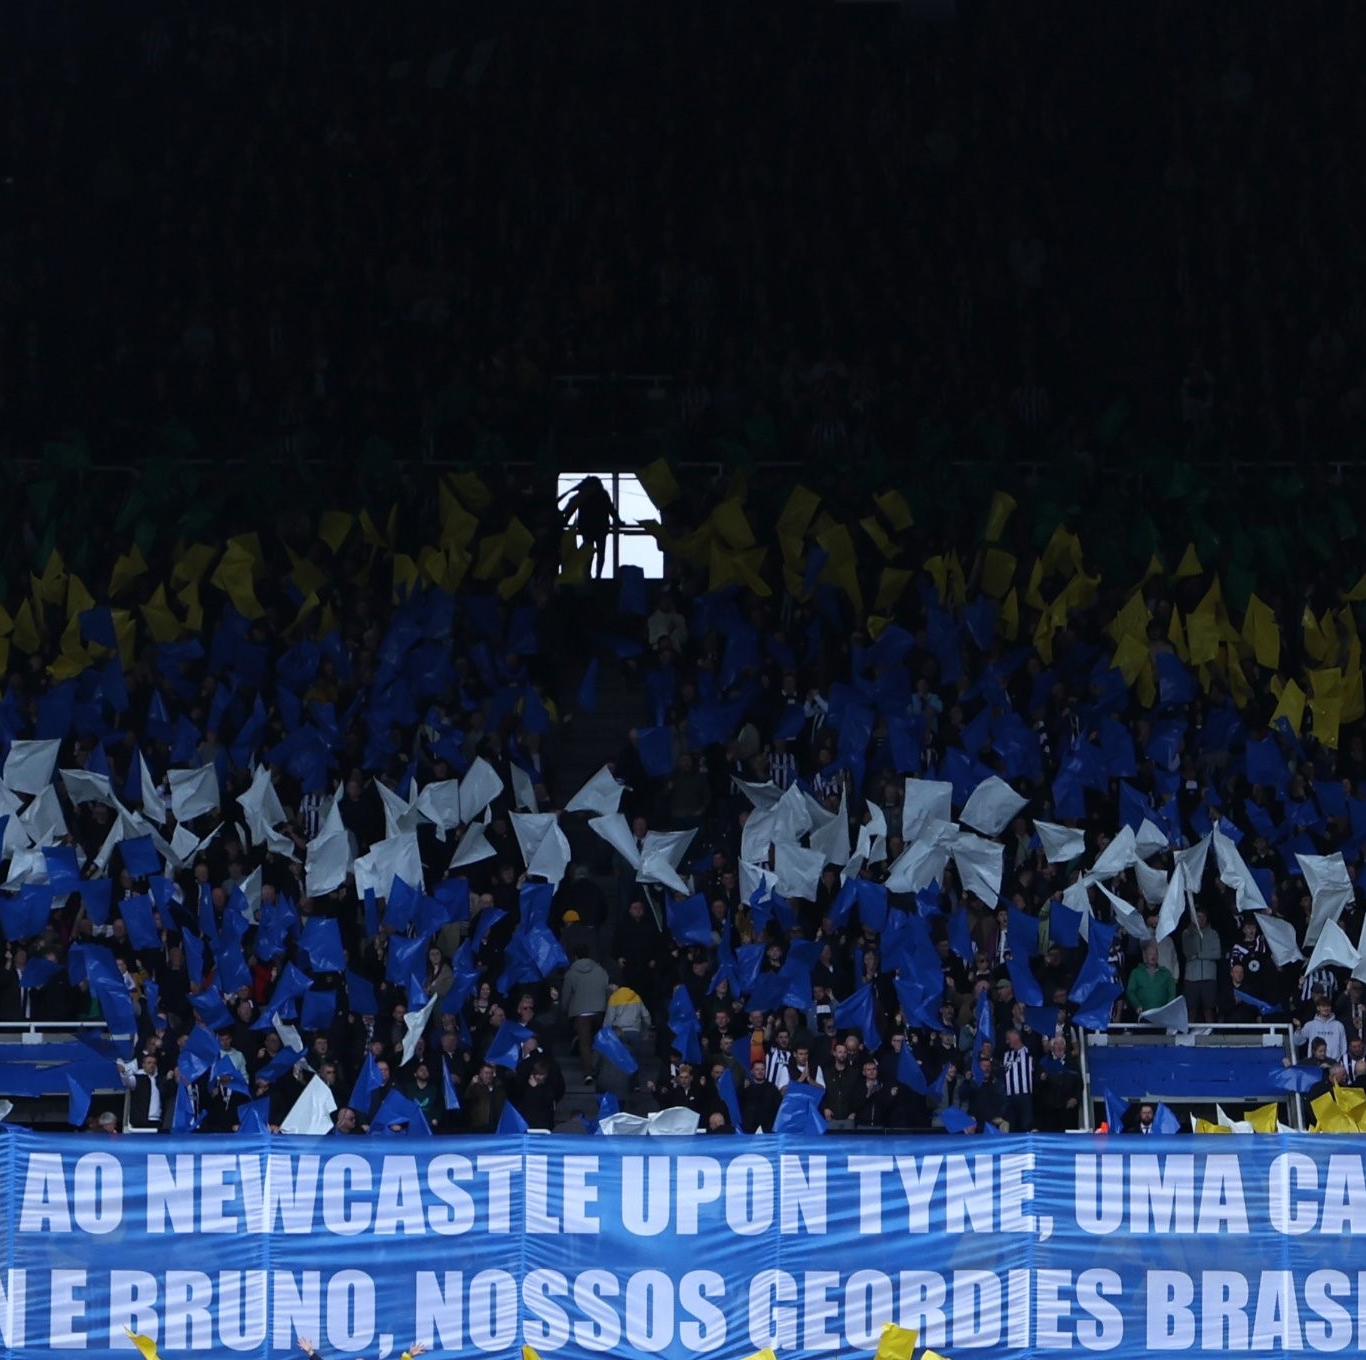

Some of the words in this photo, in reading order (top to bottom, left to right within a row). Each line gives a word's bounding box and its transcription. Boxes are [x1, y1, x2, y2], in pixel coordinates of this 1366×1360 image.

[20, 1152, 124, 1235] AO
[147, 1154, 600, 1236] NEWCASTLE
[622, 1154, 828, 1236] UPON
[848, 1153, 1053, 1242] TYNE,
[1075, 1154, 1250, 1235] UMA
[50, 1269, 88, 1349] E
[109, 1269, 394, 1359] BRUNO,
[425, 1268, 728, 1353] NOSSOS
[748, 1268, 1124, 1352] GEORDIES
